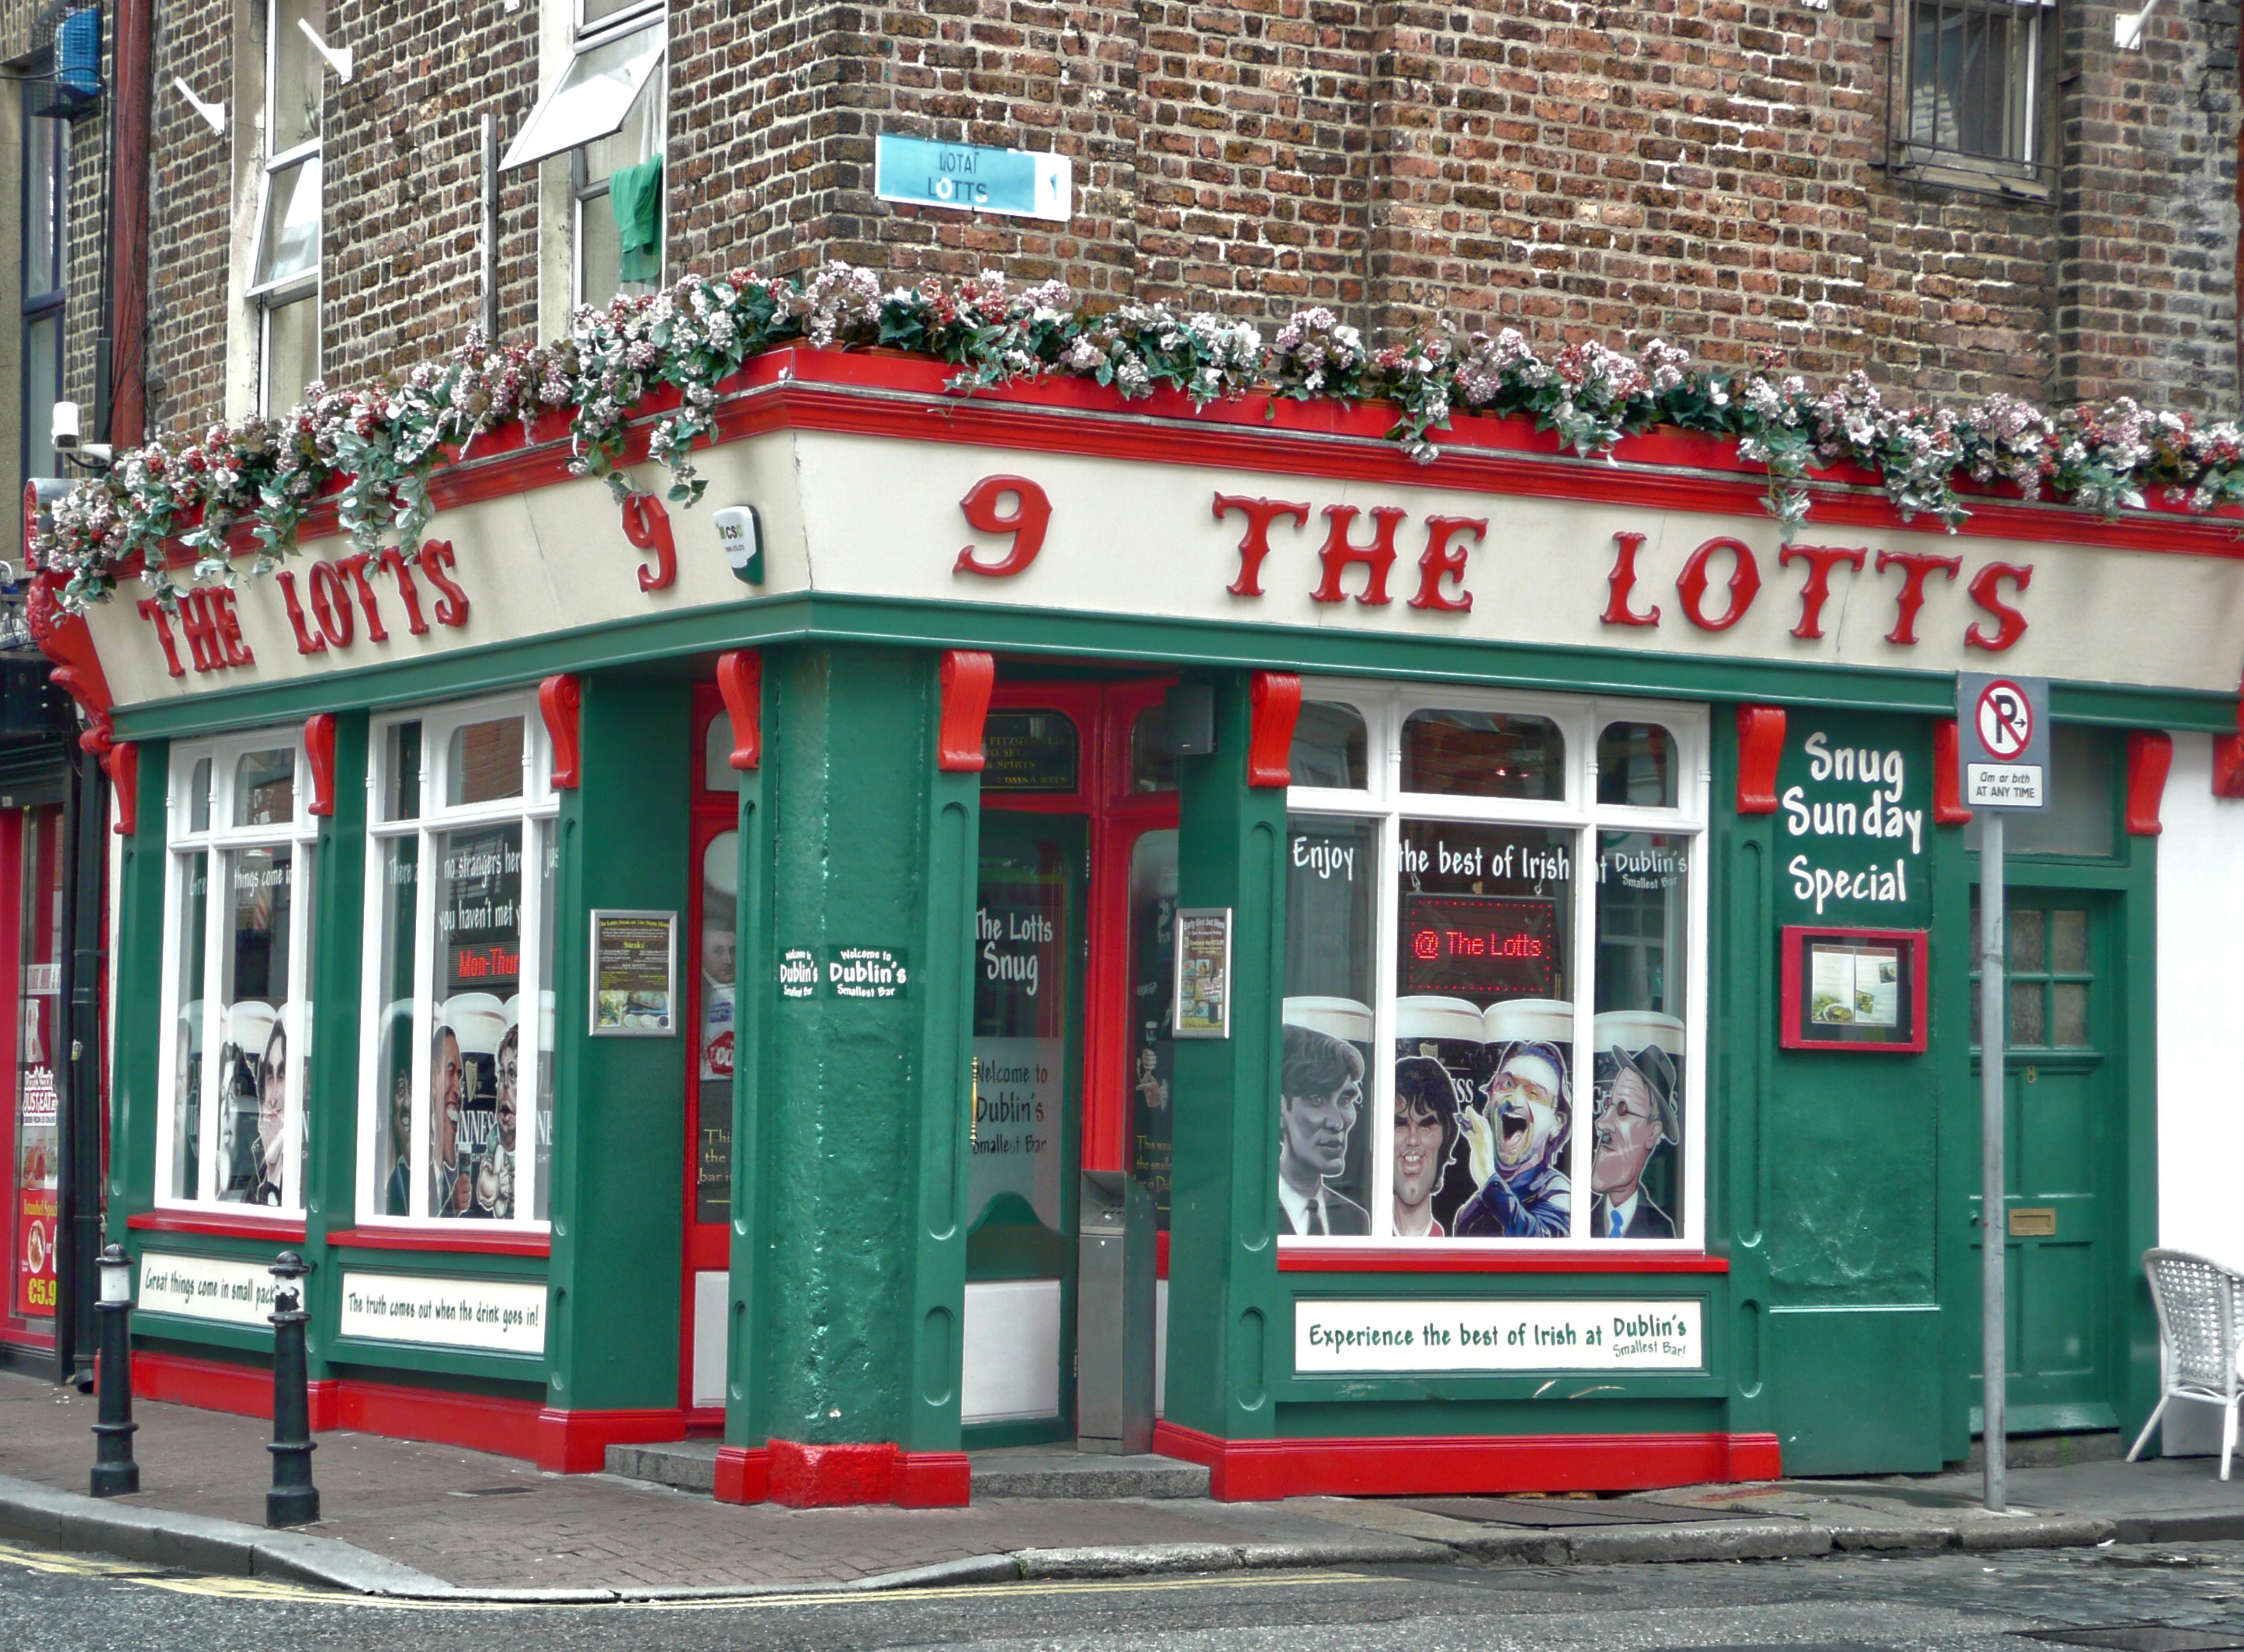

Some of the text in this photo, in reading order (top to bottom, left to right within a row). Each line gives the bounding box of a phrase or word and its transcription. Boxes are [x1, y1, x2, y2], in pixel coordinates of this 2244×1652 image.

[928, 177, 988, 203] LOTTS
[620, 491, 677, 593] 9
[953, 473, 2034, 652] 9 THE LOTTS
[137, 538, 470, 678] THE LOTTS
[1805, 732, 1903, 803] Snug
[1976, 786, 2035, 798] AT ANY TIME
[1782, 786, 1922, 855] Sunday
[388, 856, 412, 885] There
[444, 858, 455, 879] no
[458, 851, 502, 888] strangers
[504, 842, 521, 874] her
[1293, 835, 1354, 881] Enjoy
[1398, 839, 1430, 873] the
[1439, 841, 1483, 876] best
[1492, 844, 1514, 878] of
[1522, 847, 1569, 880] Irish
[1615, 849, 1688, 873] Dublin's
[234, 865, 258, 897] things
[262, 868, 283, 886] come
[1622, 873, 1659, 889] Smallest
[1789, 855, 1906, 915] Special
[438, 909, 455, 942] you
[458, 897, 492, 930] haven't
[495, 899, 513, 927] met
[975, 908, 1053, 942] The Lotts
[841, 947, 892, 961] Welcome to
[1414, 931, 1542, 959] @ The Lotts
[780, 961, 819, 983] Dublin's
[830, 961, 907, 983] Dublin's
[983, 942, 1038, 996] Snug
[837, 983, 895, 997] Smallest Bar
[1035, 1063, 1048, 1084] to
[976, 1091, 1044, 1123] Dublin's
[705, 1149, 726, 1163] the
[1025, 1134, 1047, 1153] Bar
[700, 1167, 722, 1182] bar
[145, 1266, 168, 1292] Great
[171, 1270, 194, 1304] things
[198, 1279, 218, 1297] come
[221, 1278, 229, 1299] in
[232, 1278, 253, 1303] small
[349, 1291, 539, 1333] The truth comes out when the drink goes in!
[1309, 1314, 1687, 1354] Experience the best of Irish at Dublin's
[1612, 1340, 1686, 1358] Smallest Bar!
